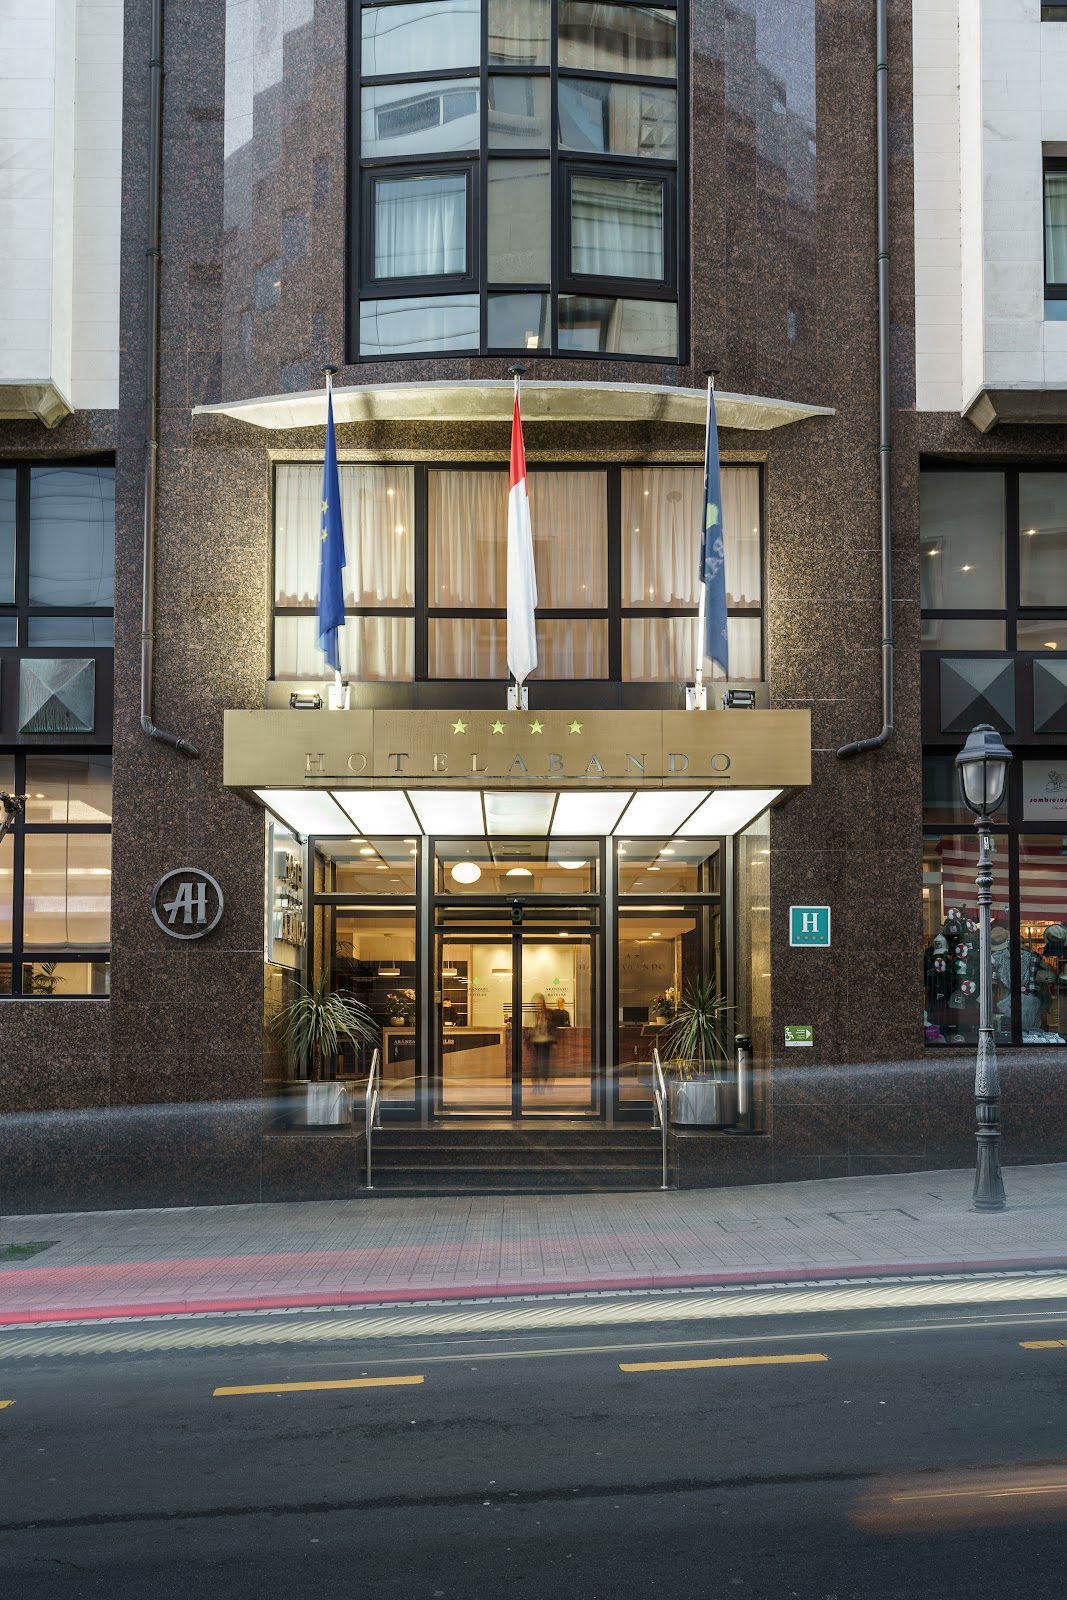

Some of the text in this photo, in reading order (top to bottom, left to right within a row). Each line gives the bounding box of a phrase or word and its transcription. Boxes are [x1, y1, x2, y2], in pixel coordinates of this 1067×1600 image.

[304, 753, 731, 772] HOTEL ABANDO
[801, 912, 819, 933] H
